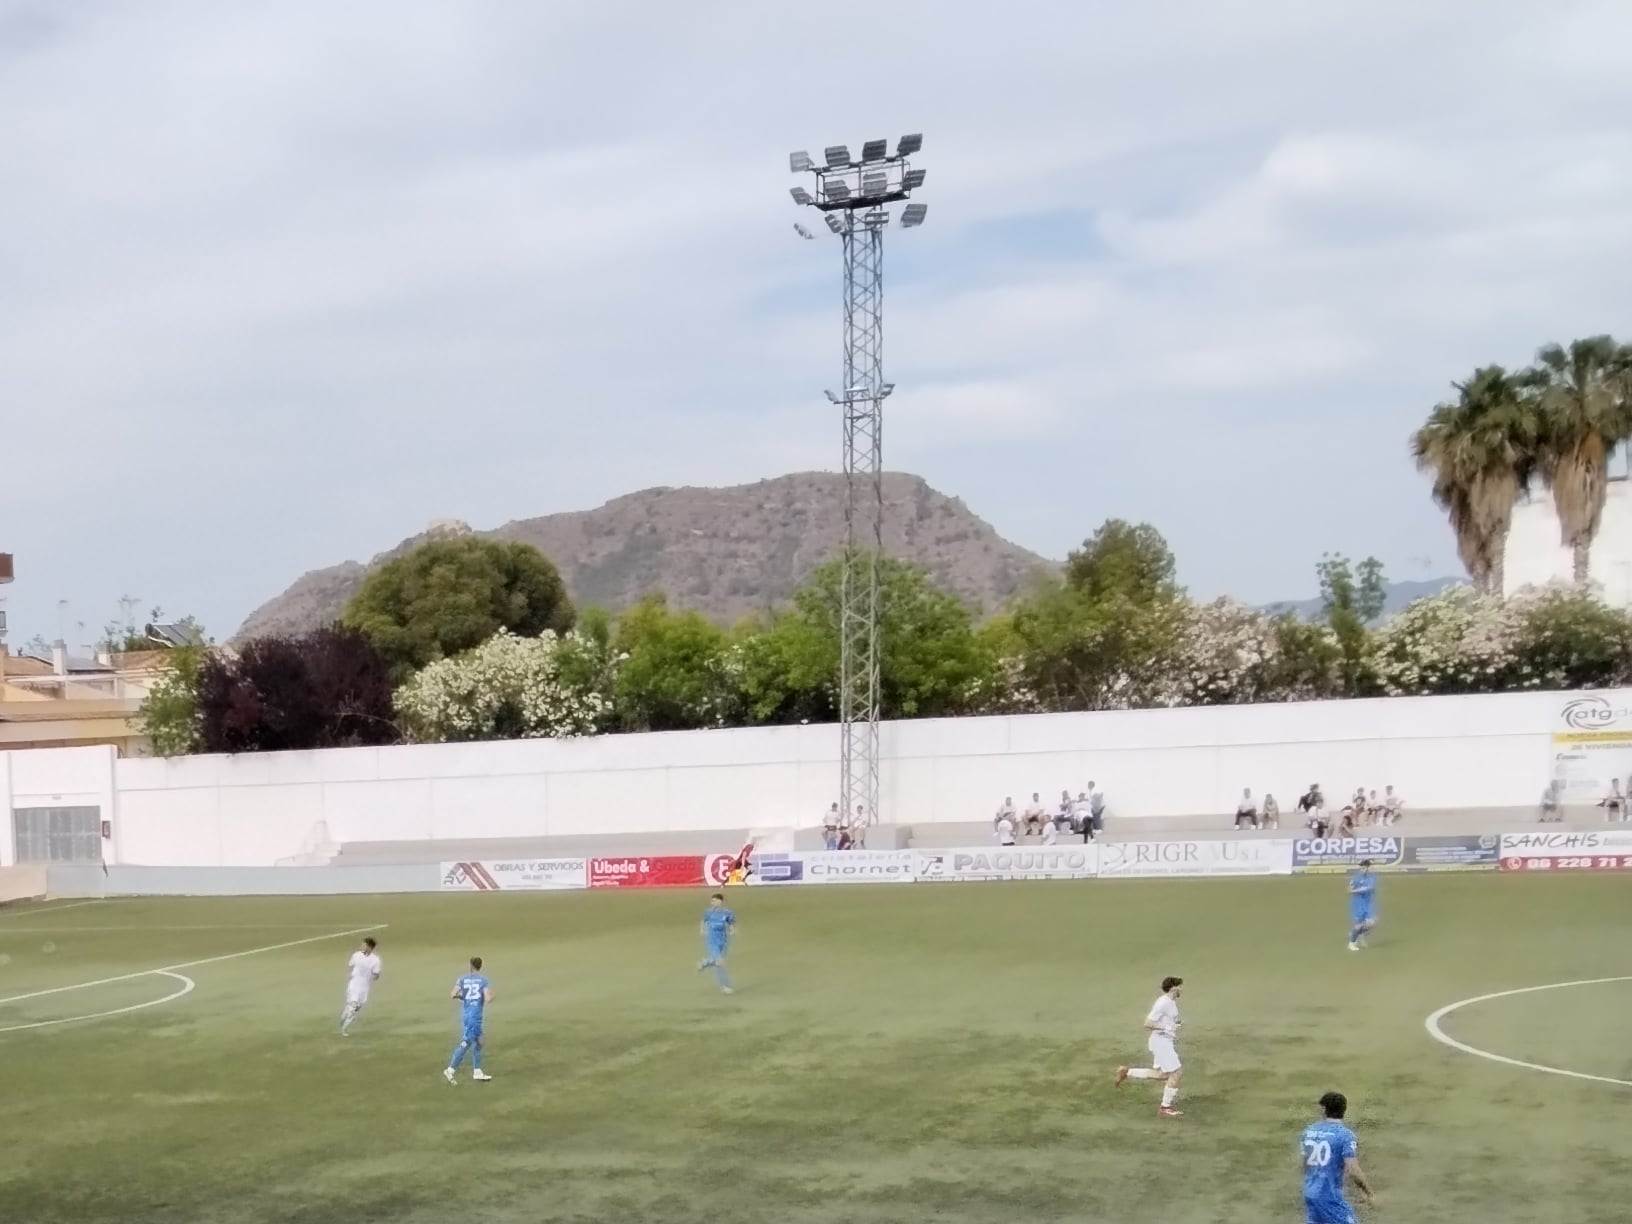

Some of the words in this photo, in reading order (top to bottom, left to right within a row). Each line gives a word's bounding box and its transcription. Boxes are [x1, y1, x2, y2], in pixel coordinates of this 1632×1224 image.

[1296, 836, 1399, 855] CORPESA
[1503, 832, 1600, 849] SANCHIS
[1135, 841, 1240, 863] RIGRU
[494, 863, 526, 872] OBRAS
[528, 863, 535, 871] Y
[537, 862, 584, 871] SERVICIOS
[639, 859, 650, 873] &
[954, 851, 1086, 871] PAQUITO
[810, 864, 912, 876] Chornet
[463, 983, 481, 1000] 23
[1304, 1139, 1332, 1167] 20
